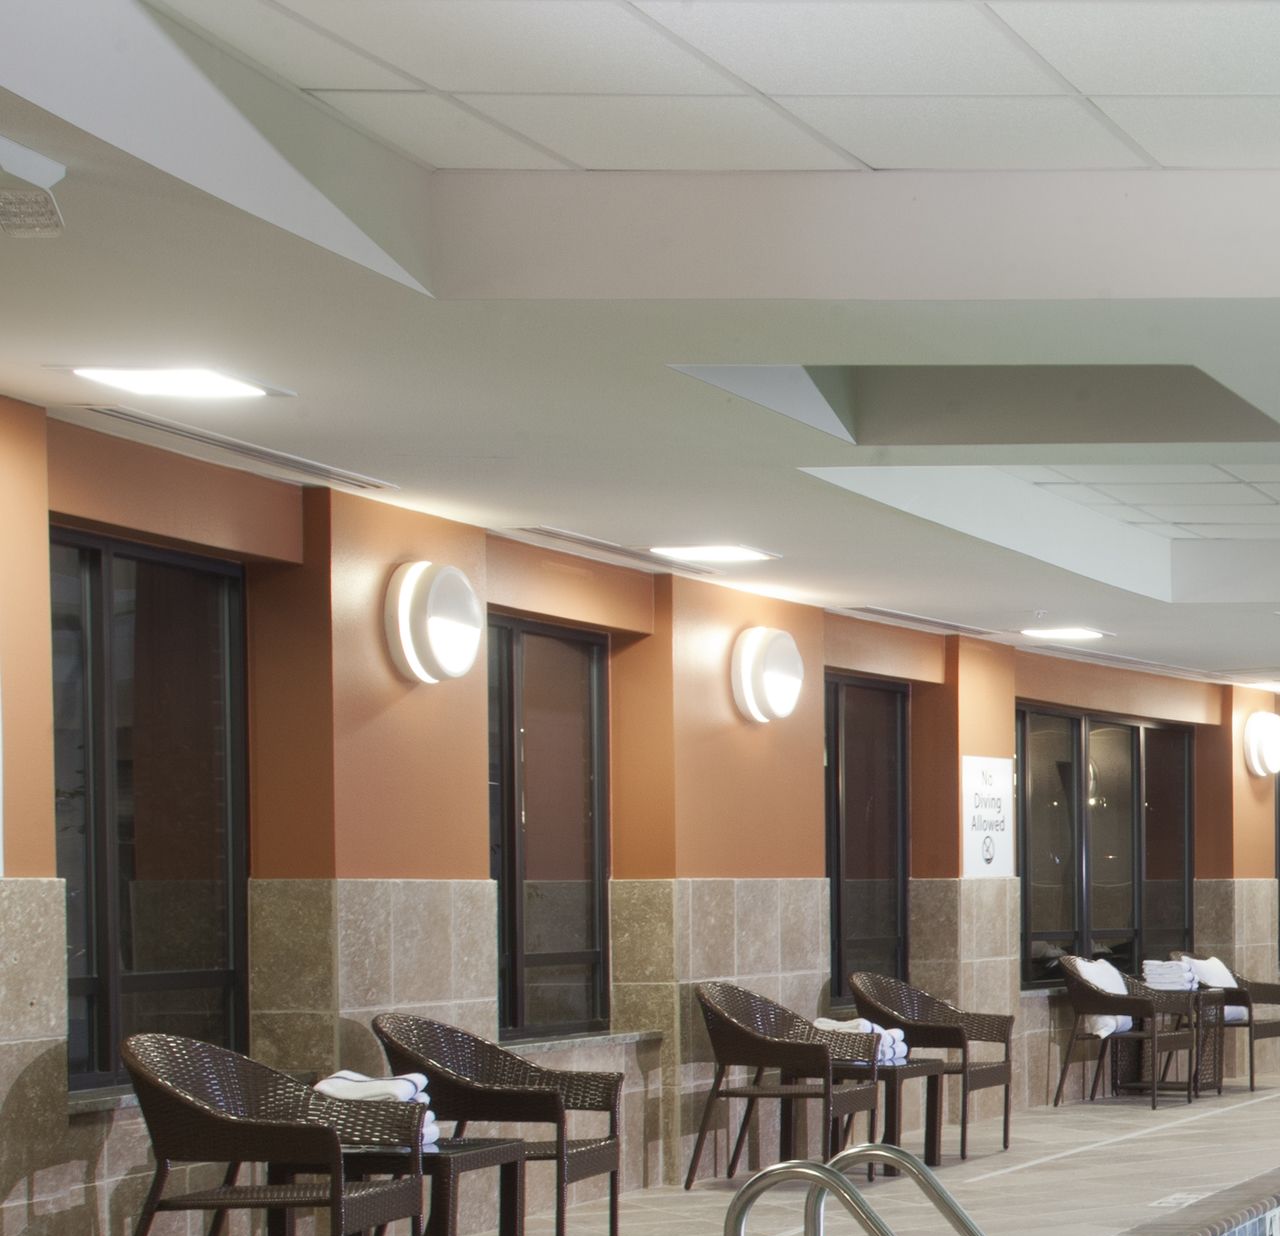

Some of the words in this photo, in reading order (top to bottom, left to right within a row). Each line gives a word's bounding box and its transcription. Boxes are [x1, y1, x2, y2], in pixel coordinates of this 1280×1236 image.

[981, 770, 993, 786] No
[974, 792, 1002, 814] Diving
[971, 815, 1006, 832] Allowed
